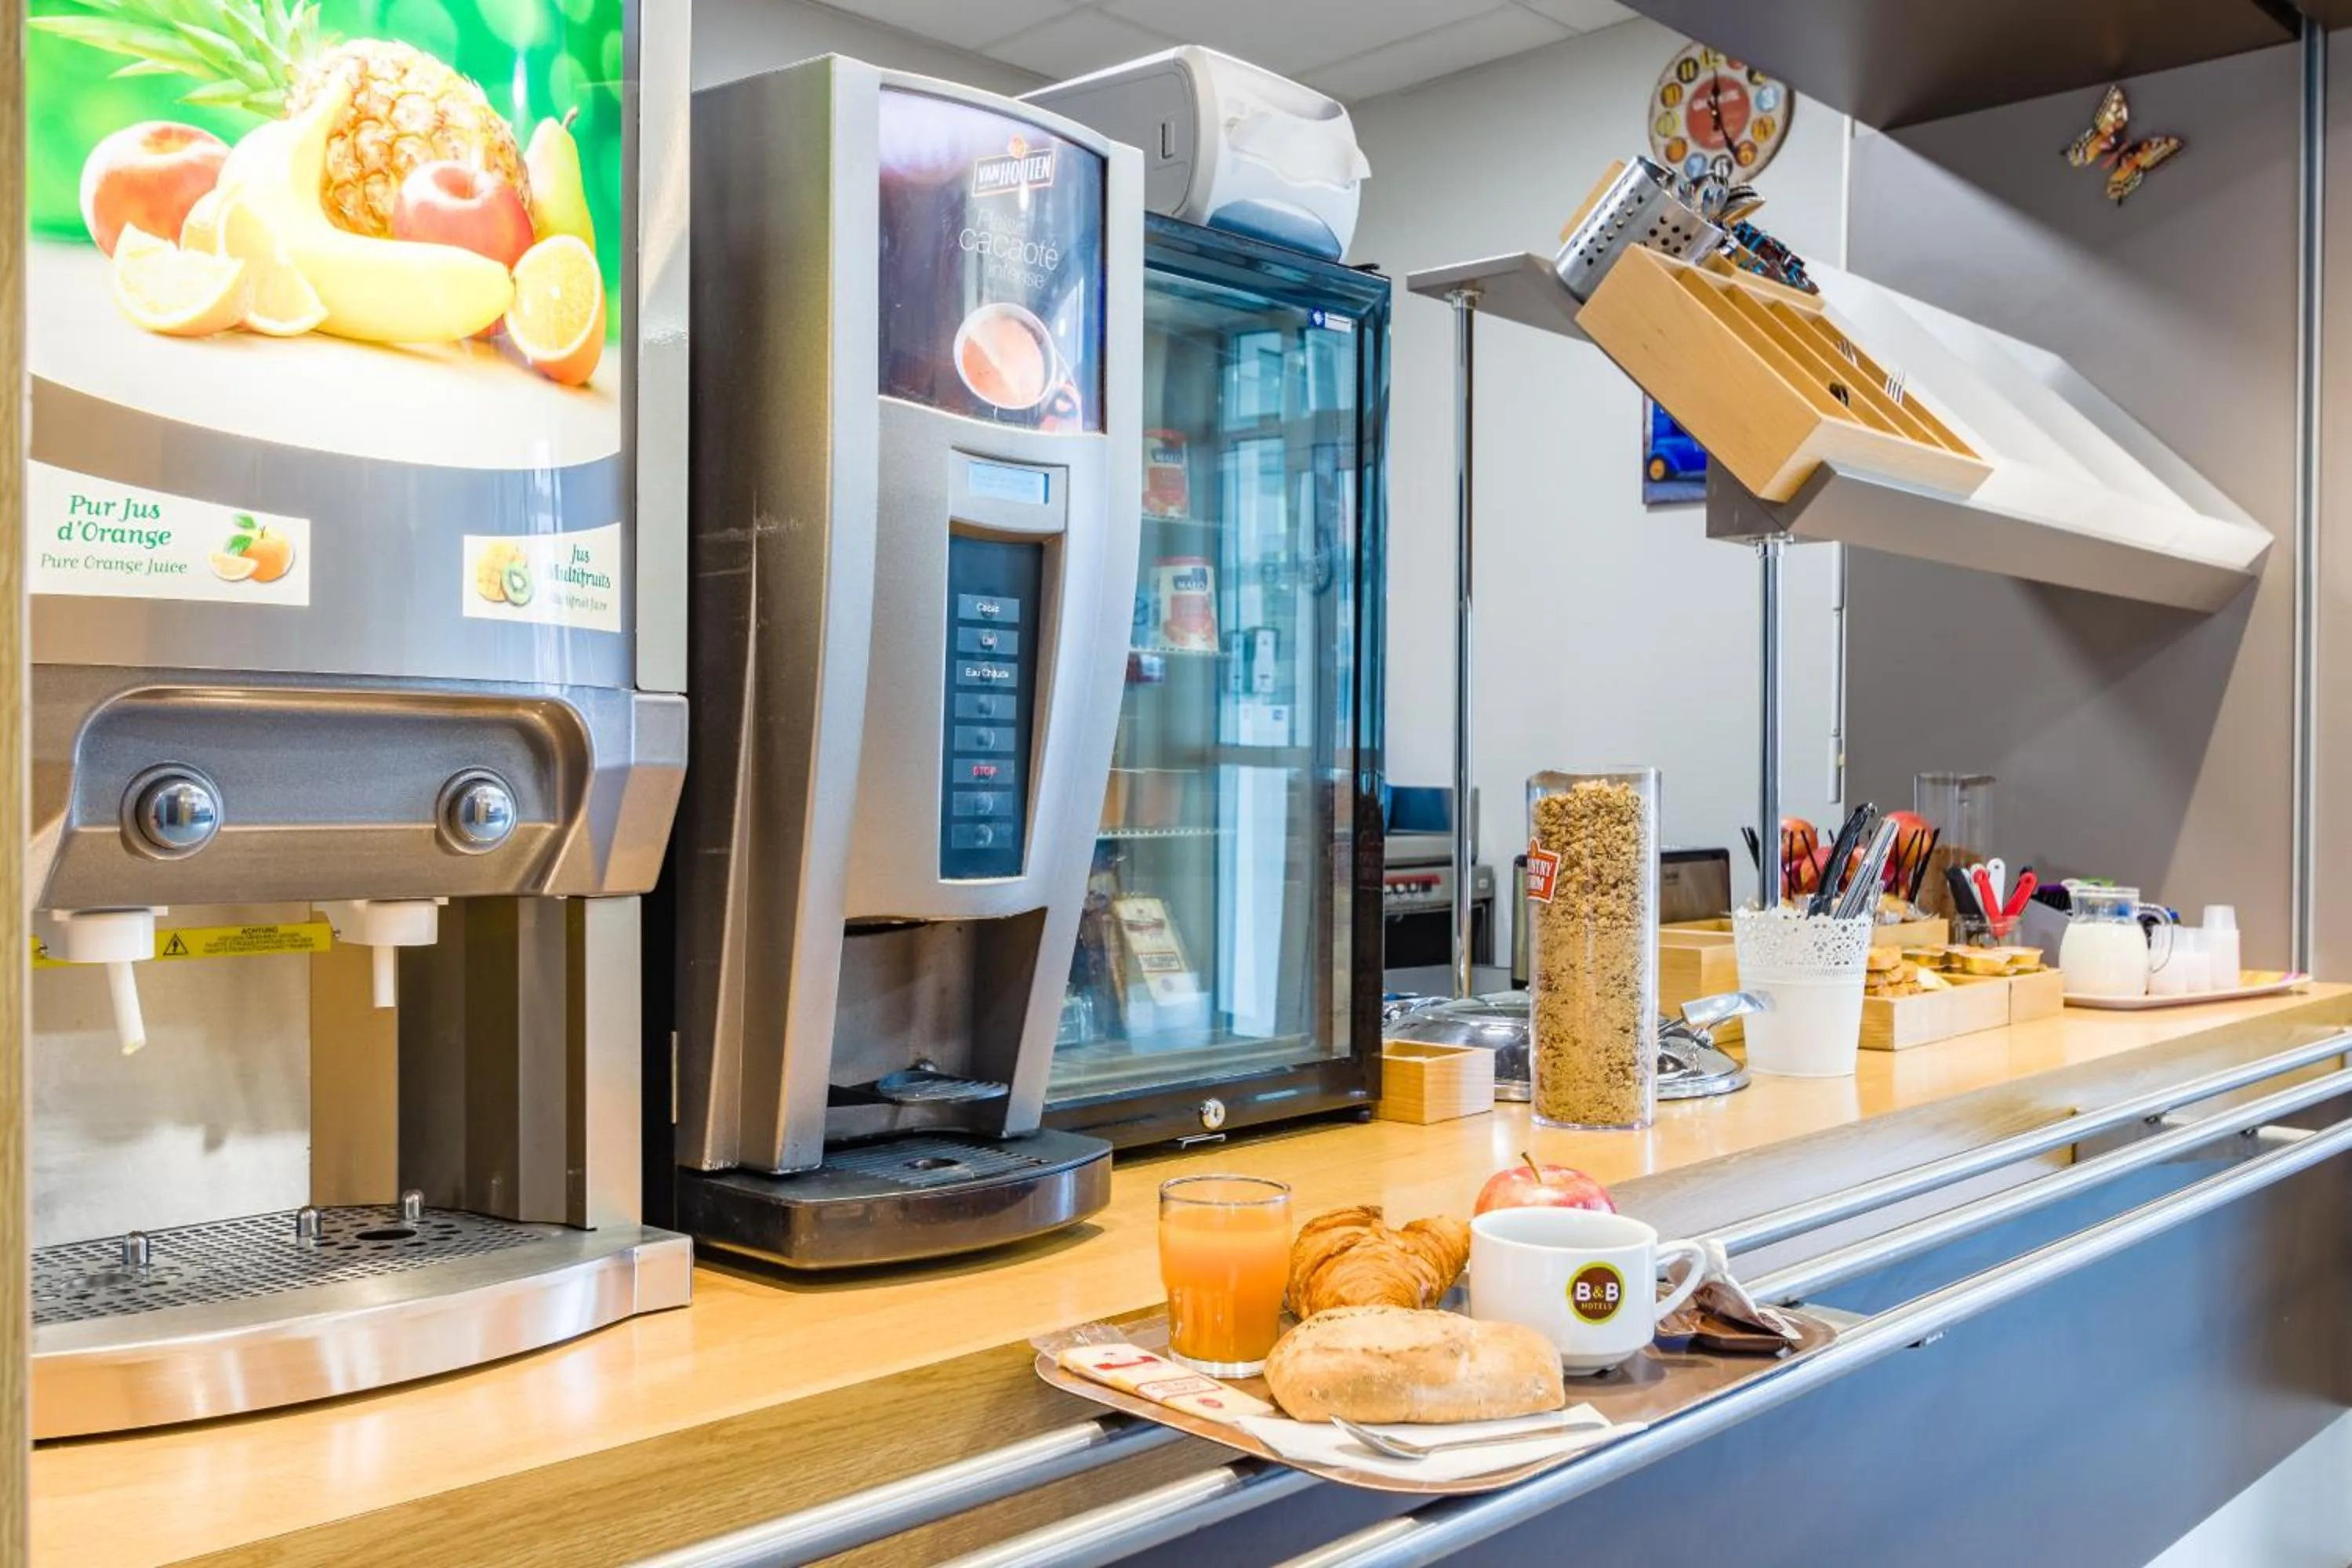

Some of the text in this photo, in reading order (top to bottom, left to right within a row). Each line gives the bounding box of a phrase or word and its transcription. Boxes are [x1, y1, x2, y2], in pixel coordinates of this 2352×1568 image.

[960, 228, 1058, 270] cacaoté
[69, 495, 161, 522] Pur Jus
[57, 521, 172, 550] d'Orange
[41, 553, 188, 576] Pure Orange Juice
[571, 543, 590, 564] Jus
[965, 667, 980, 677] Eau
[1576, 1281, 1619, 1302] B&B
[1581, 1301, 1613, 1311] HOTELS
